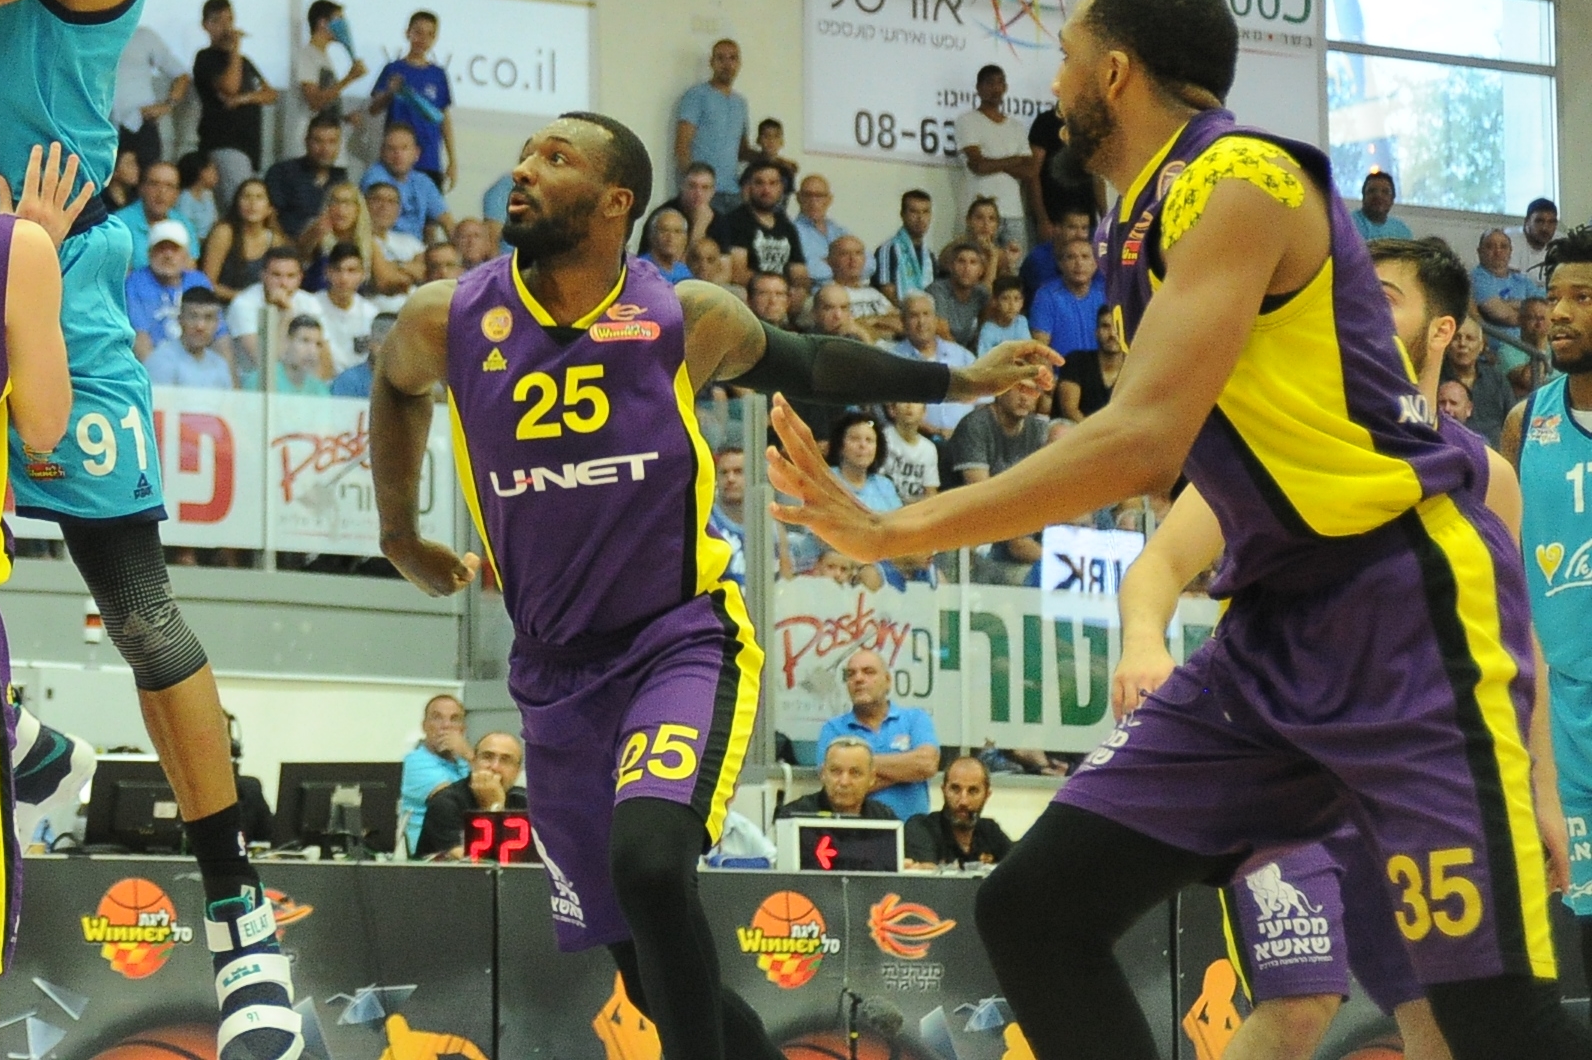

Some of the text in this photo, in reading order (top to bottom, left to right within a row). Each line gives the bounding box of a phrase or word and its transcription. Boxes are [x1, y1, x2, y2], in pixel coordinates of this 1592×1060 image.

[855, 110, 958, 158] 08-63
[513, 364, 610, 440] 25
[76, 405, 148, 477] 91
[616, 723, 699, 795] 25
[1386, 847, 1483, 941] 35
[81, 915, 173, 943] Winner
[172, 921, 193, 942] סל
[244, 914, 269, 937] EILAT
[1258, 917, 1328, 939] מסיעי
[736, 927, 821, 954] Winner
[821, 934, 841, 954] סל
[1253, 936, 1332, 962] שאשא
[246, 1011, 260, 1022] 91
